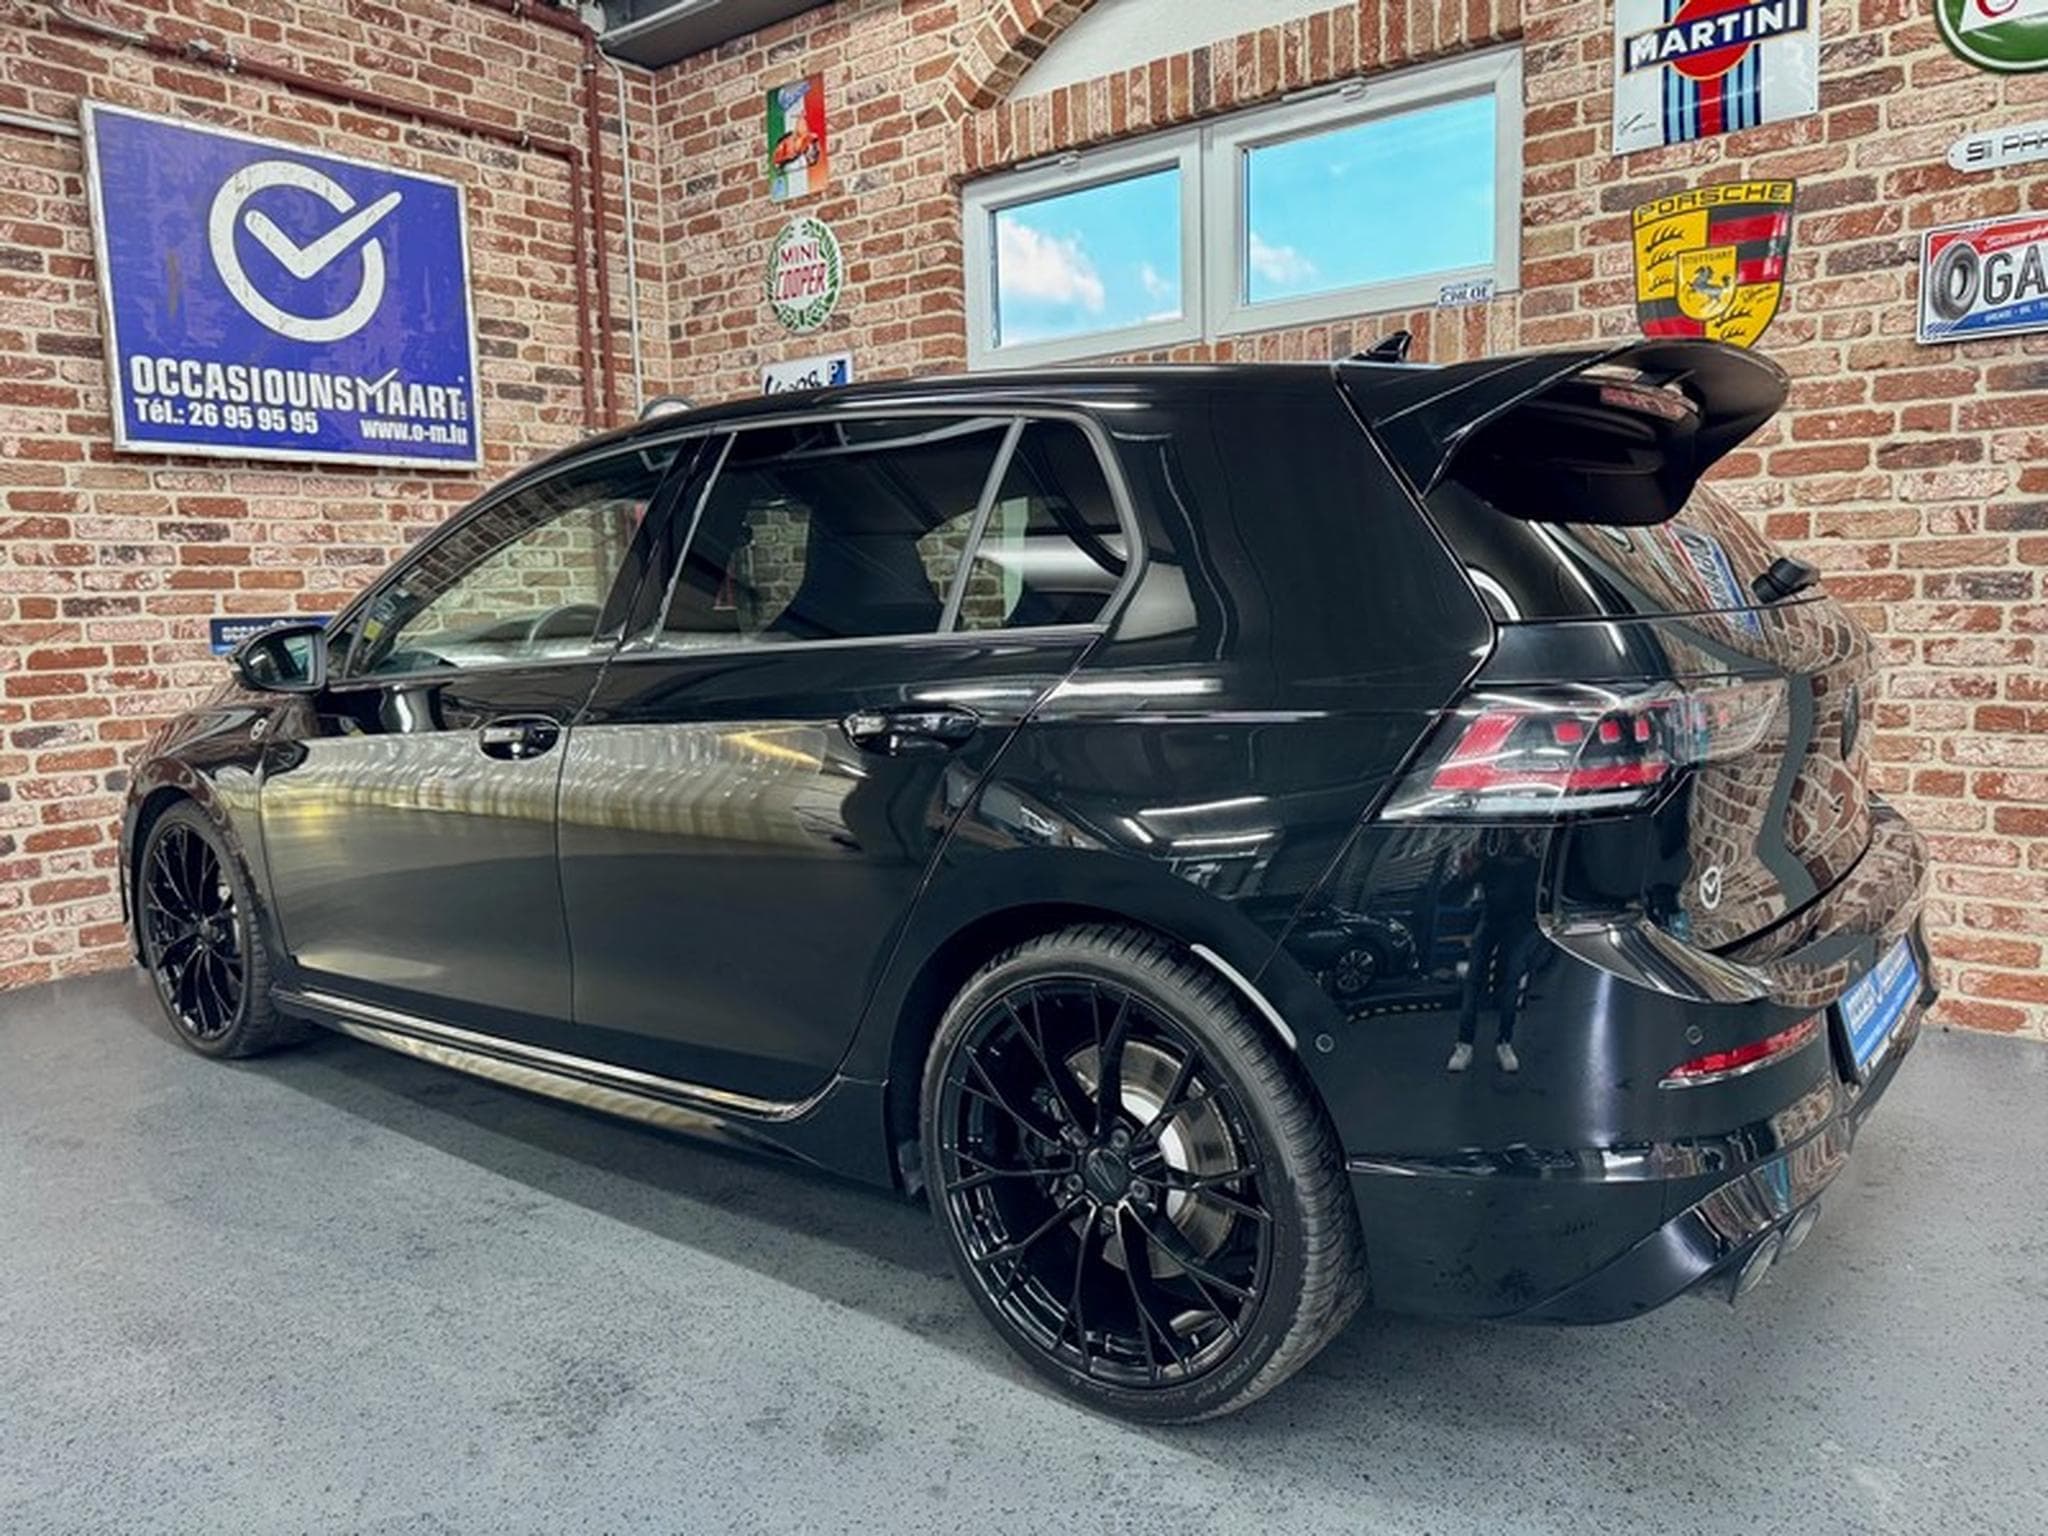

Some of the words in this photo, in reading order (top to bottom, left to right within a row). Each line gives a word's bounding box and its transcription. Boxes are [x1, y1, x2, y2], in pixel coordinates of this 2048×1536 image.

[1629, 0, 1798, 66] MARTINI
[1637, 183, 1789, 222] PORSCHE
[780, 242, 818, 265] MINI
[776, 263, 827, 300] COOPER
[130, 354, 462, 420] OCCASIOUNSMAART
[134, 397, 185, 425] Tél.:
[188, 402, 218, 428] 26
[222, 404, 253, 430] 95
[257, 407, 287, 433] 95
[290, 411, 319, 435] 95
[360, 418, 468, 446] www.o-m.lu
